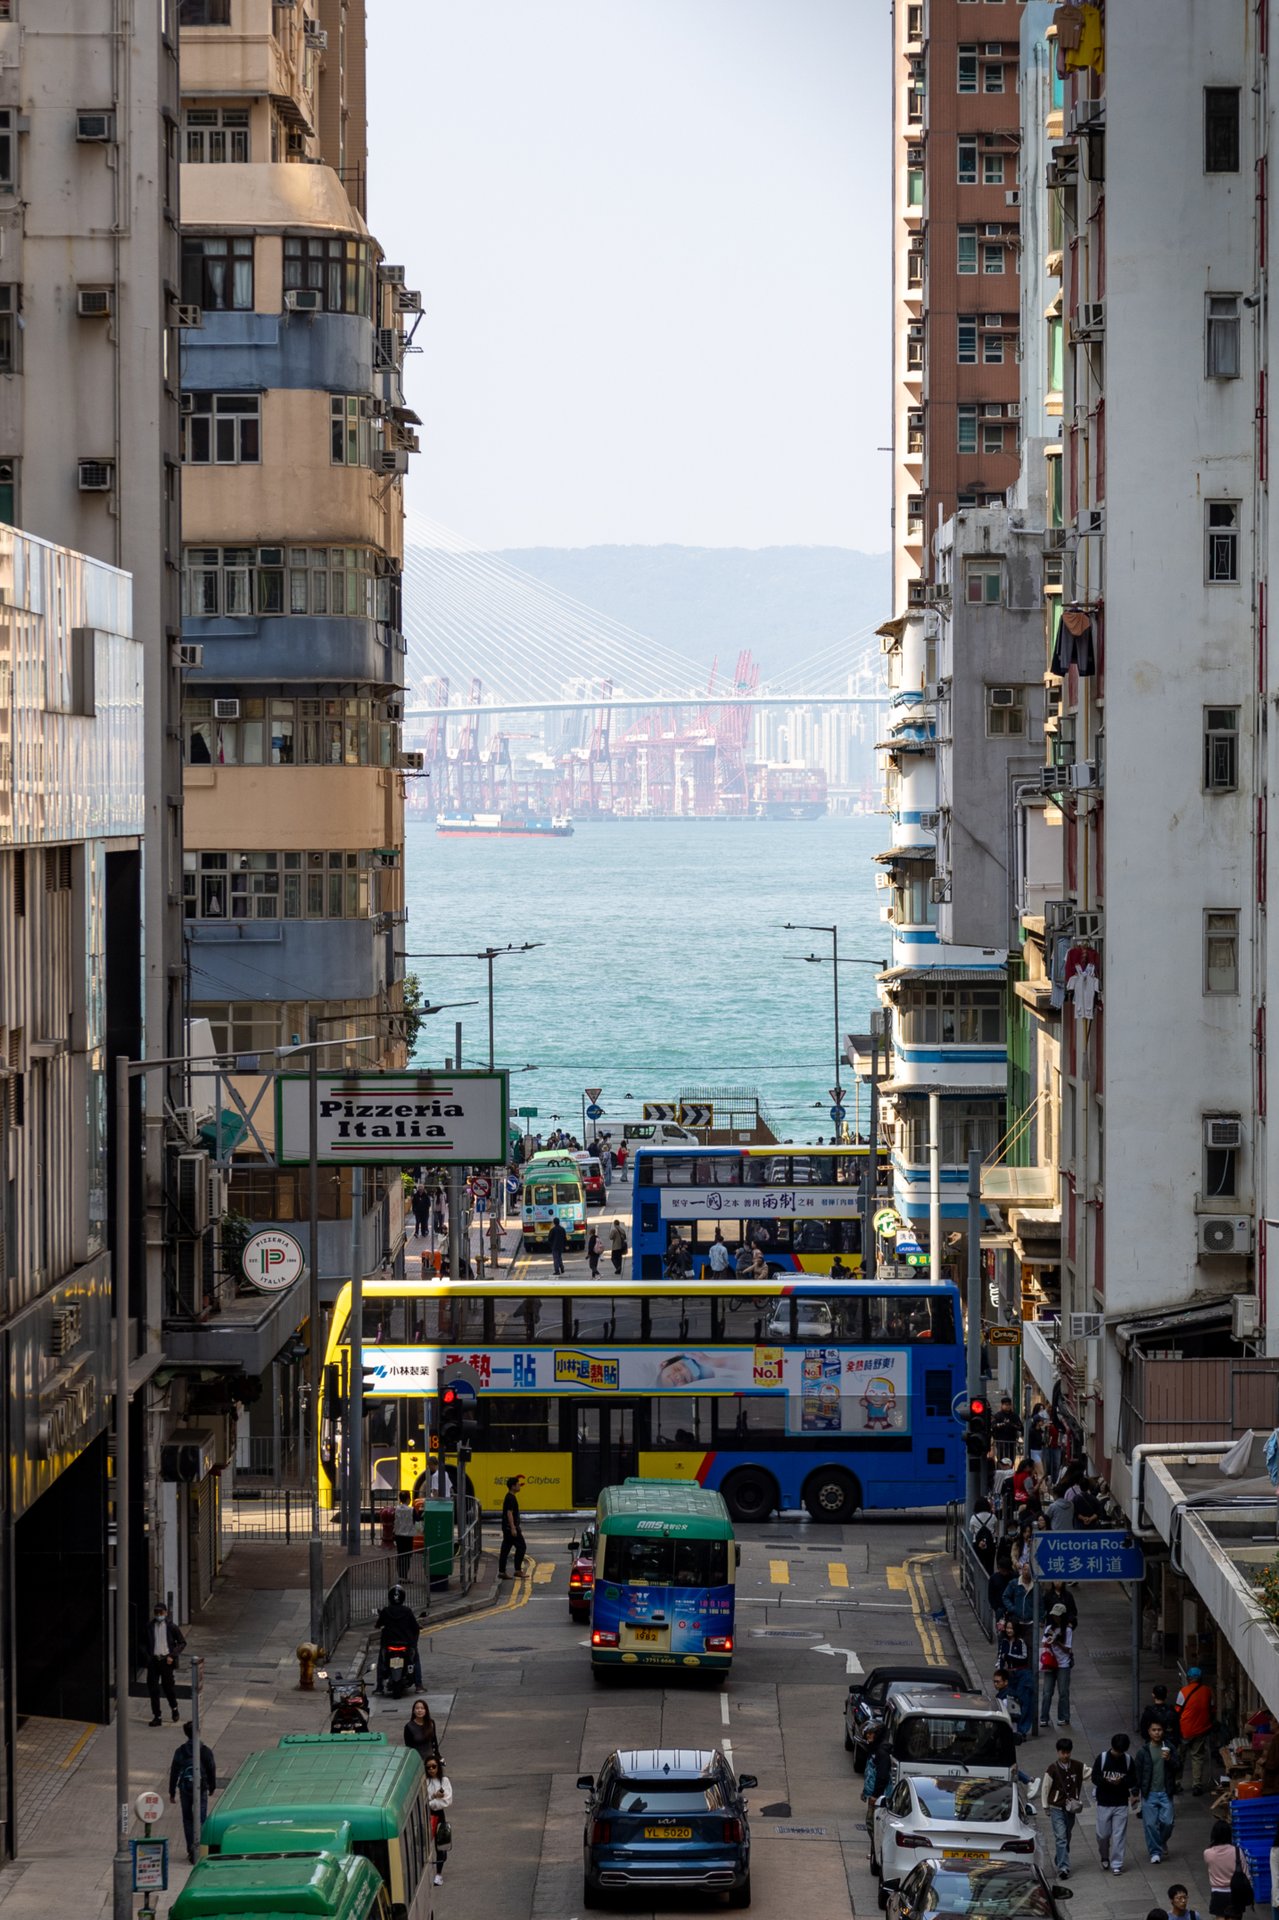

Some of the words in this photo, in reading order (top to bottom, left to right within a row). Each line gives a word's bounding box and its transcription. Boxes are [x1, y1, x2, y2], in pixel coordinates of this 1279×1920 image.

[320, 1100, 464, 1117] Pizzeria
[338, 1120, 446, 1137] Italia
[255, 1237, 290, 1248] PIZZERIA
[260, 1276, 287, 1285] ITALIA
[556, 1358, 617, 1385] 小林退熱貼
[527, 1475, 561, 1486] Citybus
[637, 1520, 664, 1529] AMS
[1047, 1538, 1099, 1551] Victoria
[1047, 1555, 1123, 1573] 域多利道
[647, 1827, 660, 1838] YL
[663, 1827, 690, 1838] 5020
